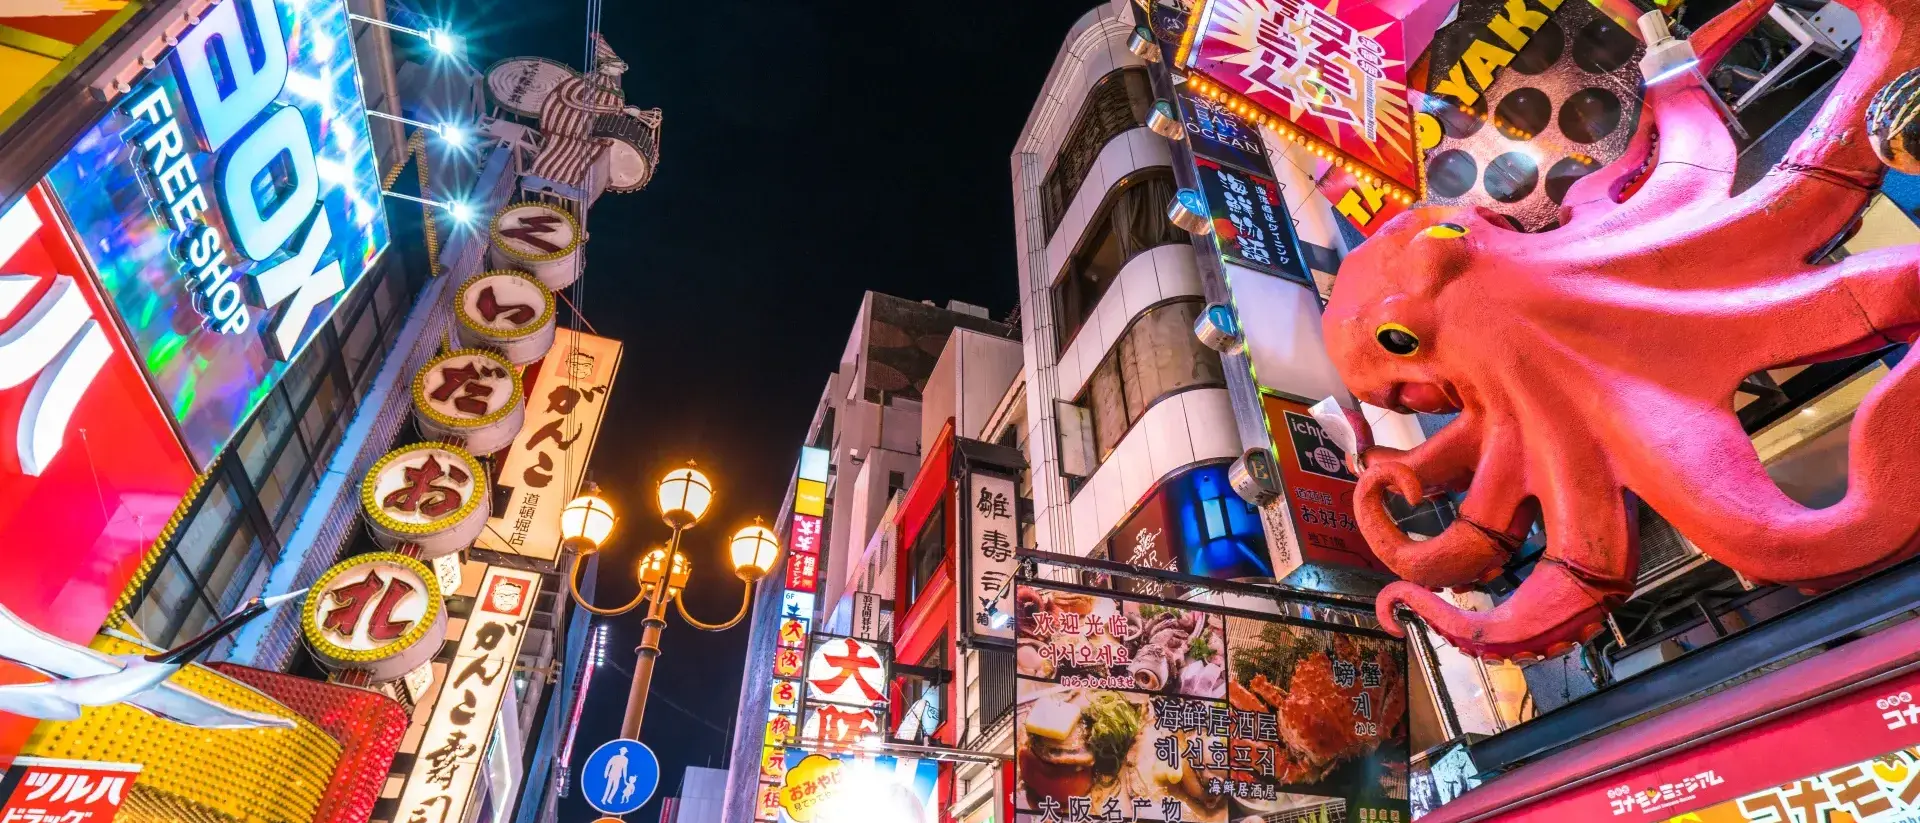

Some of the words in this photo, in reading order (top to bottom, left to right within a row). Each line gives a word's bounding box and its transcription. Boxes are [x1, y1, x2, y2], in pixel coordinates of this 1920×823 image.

[1432, 0, 1564, 106] YAK
[1196, 108, 1239, 131] BAR
[1186, 122, 1261, 154] OCEAN
[131, 86, 209, 233] FREE
[190, 227, 250, 335] SHOP
[523, 384, 608, 489] がんこ
[510, 492, 540, 546] 道頓堀店
[1033, 612, 1128, 636] 欢迎光临
[1039, 643, 1132, 667] 어서오세요
[1061, 675, 1134, 688] いらっしゃいませ
[1333, 660, 1381, 688] 螃蟹
[1355, 721, 1377, 736] かに
[1154, 735, 1276, 777] 해선호프집
[25, 772, 126, 806] ツルハ
[1208, 777, 1277, 800] 海鮮居酒屋
[1039, 796, 1182, 823] 大阪名产物
